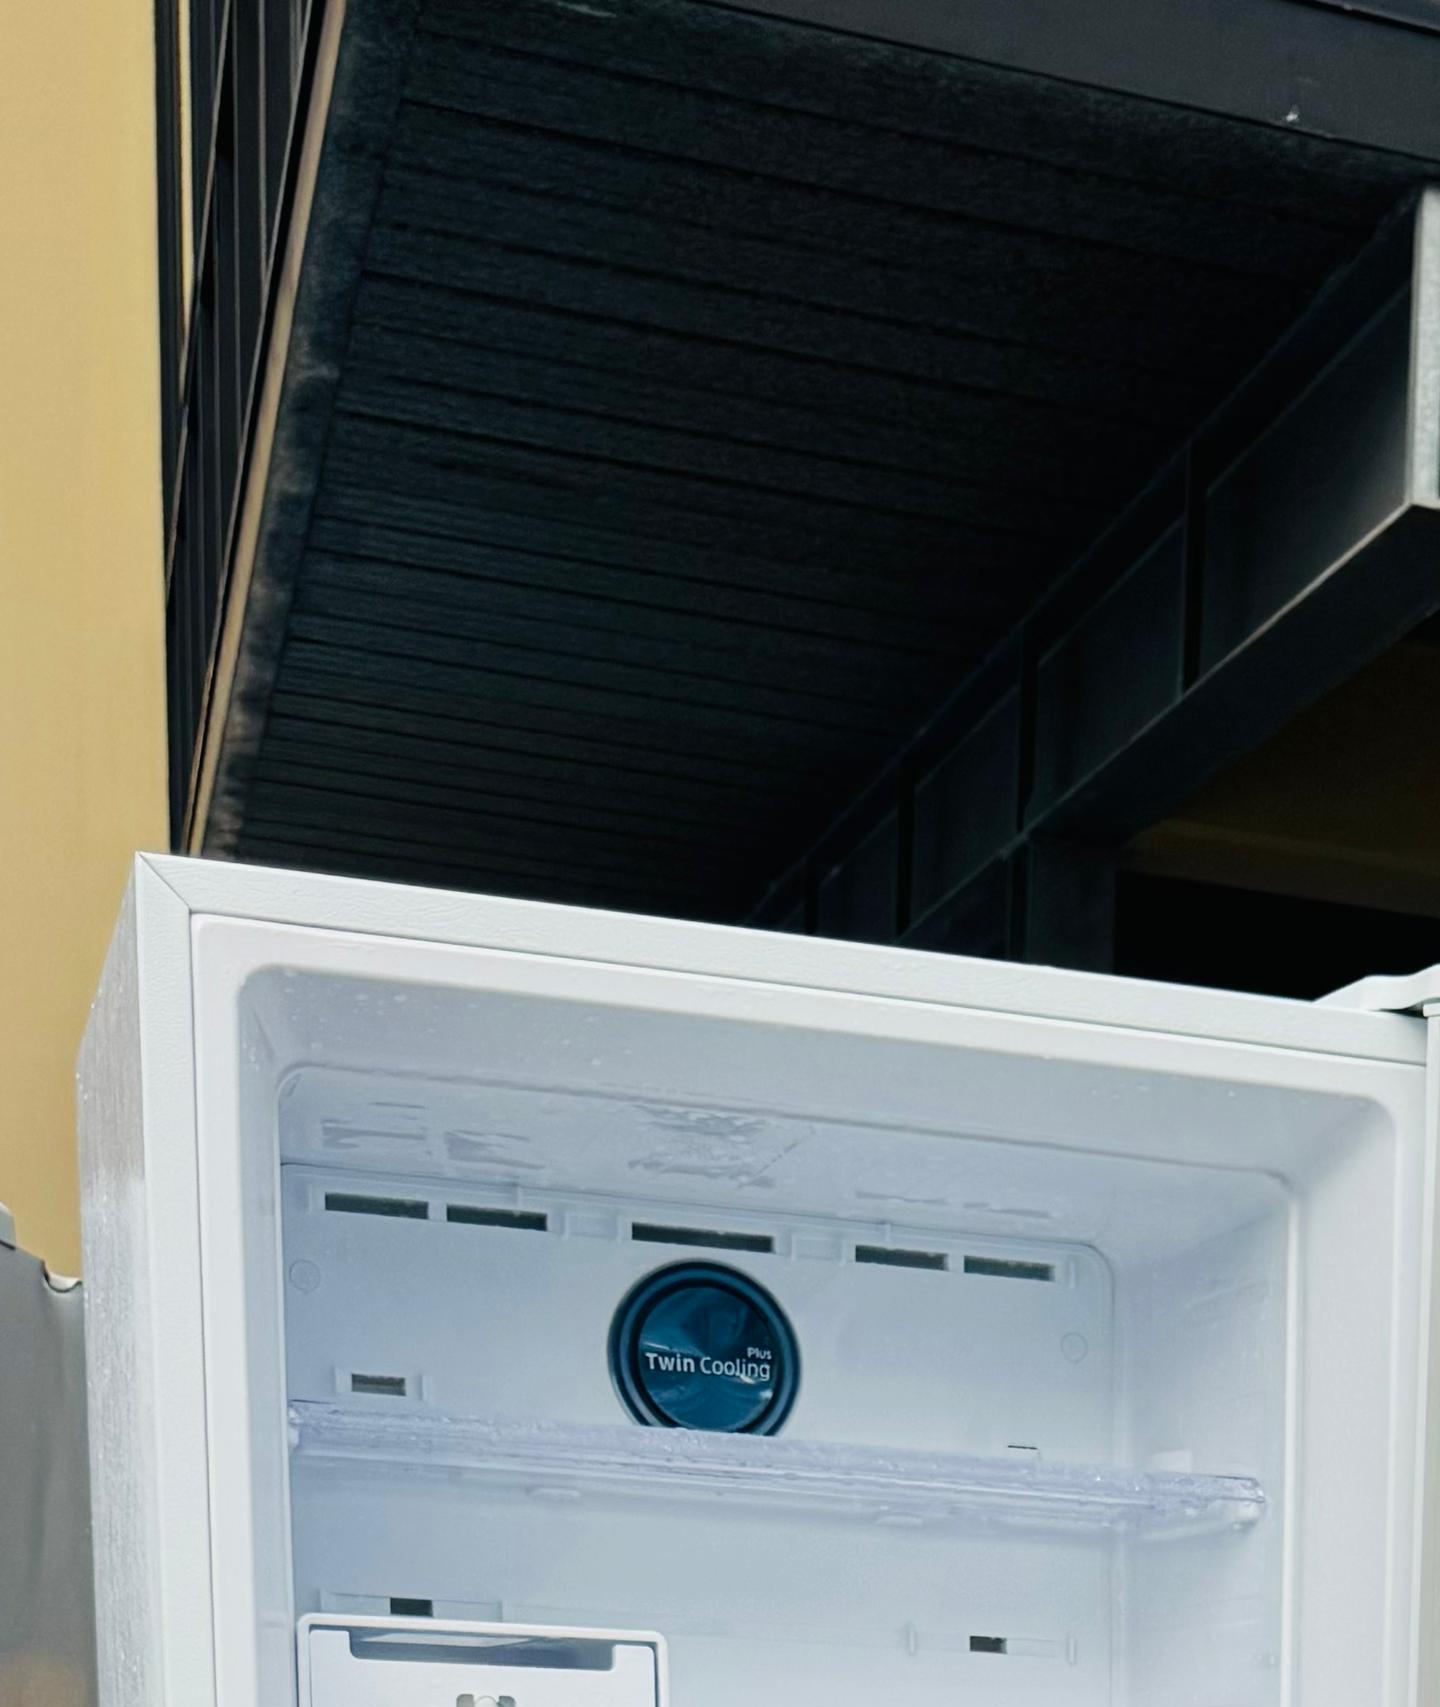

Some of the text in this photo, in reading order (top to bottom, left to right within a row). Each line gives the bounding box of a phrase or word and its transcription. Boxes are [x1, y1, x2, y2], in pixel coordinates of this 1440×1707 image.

[746, 1347, 772, 1359] Plus
[645, 1352, 771, 1381] Twin Cooling
